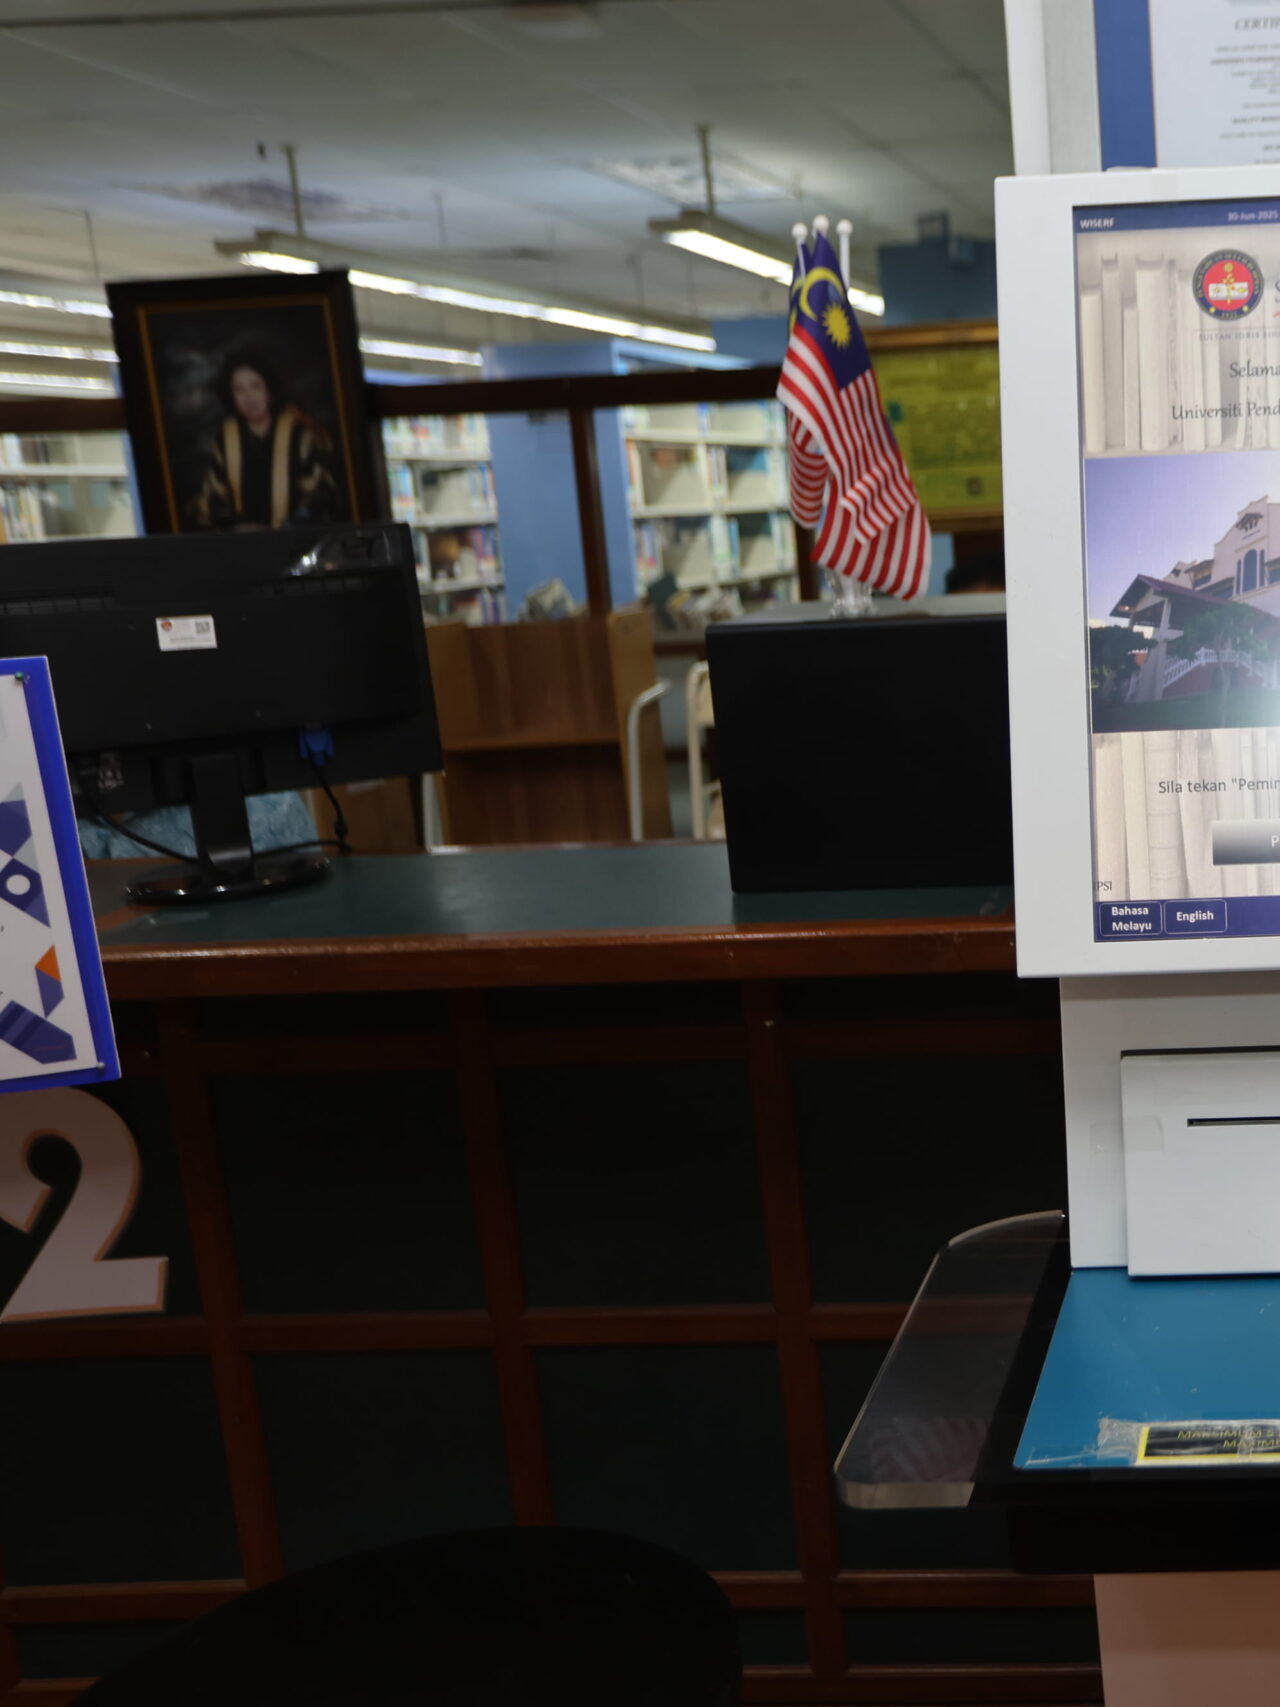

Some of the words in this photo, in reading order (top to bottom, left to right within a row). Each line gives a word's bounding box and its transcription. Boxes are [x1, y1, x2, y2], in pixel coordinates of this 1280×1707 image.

[1171, 403, 1242, 420] Universiti
[1159, 781, 1182, 793] Sila
[1187, 778, 1227, 793] tekan
[1112, 906, 1149, 916] Bahasa
[1176, 911, 1214, 923] English
[1112, 921, 1152, 932] Melayu
[0, 1086, 168, 1323] 2
